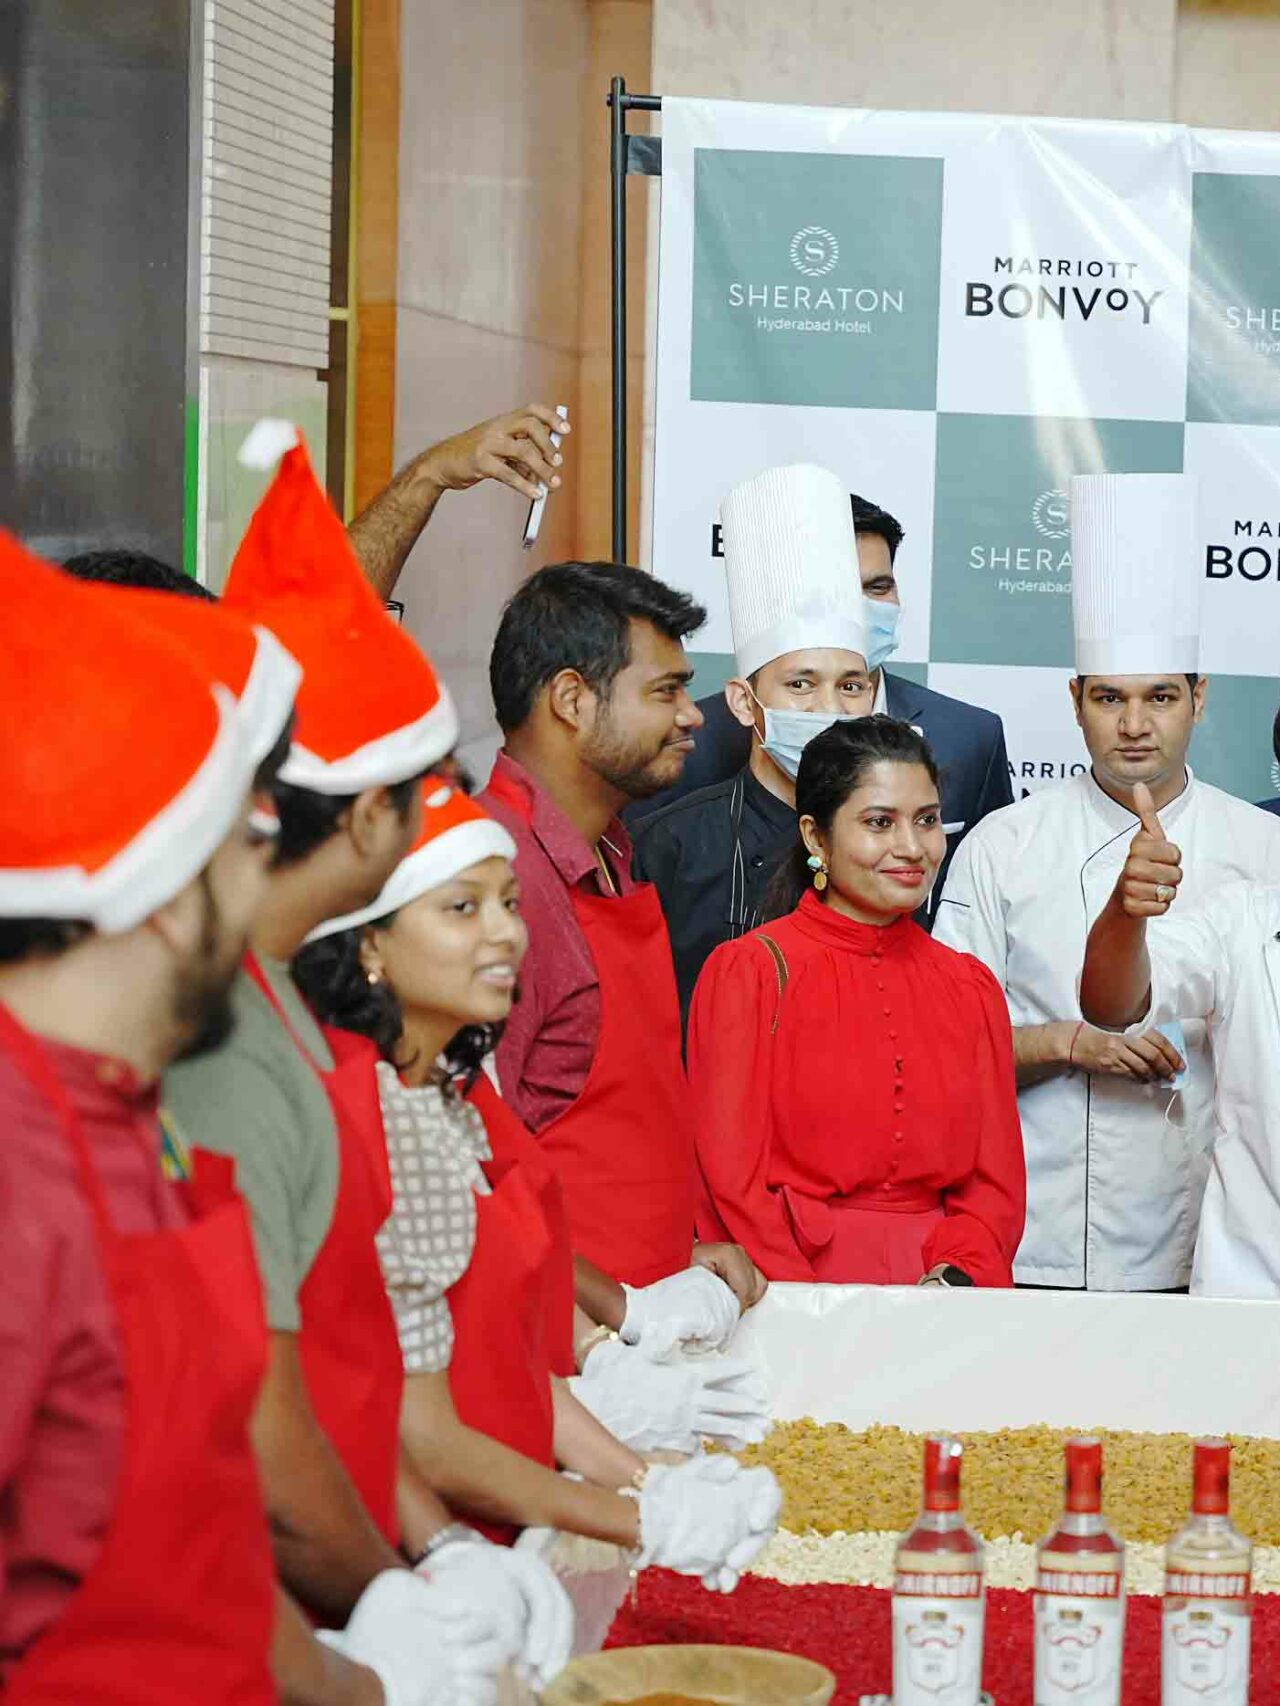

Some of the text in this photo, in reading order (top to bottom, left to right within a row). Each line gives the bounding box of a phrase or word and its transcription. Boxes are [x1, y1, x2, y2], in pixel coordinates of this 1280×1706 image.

[994, 256, 1138, 279] MARRIOTT
[728, 283, 904, 313] SHERATON
[757, 316, 872, 334] Hyderabad Hotel
[969, 546, 1072, 572] SHERA
[1008, 761, 1086, 779] ARRIO
